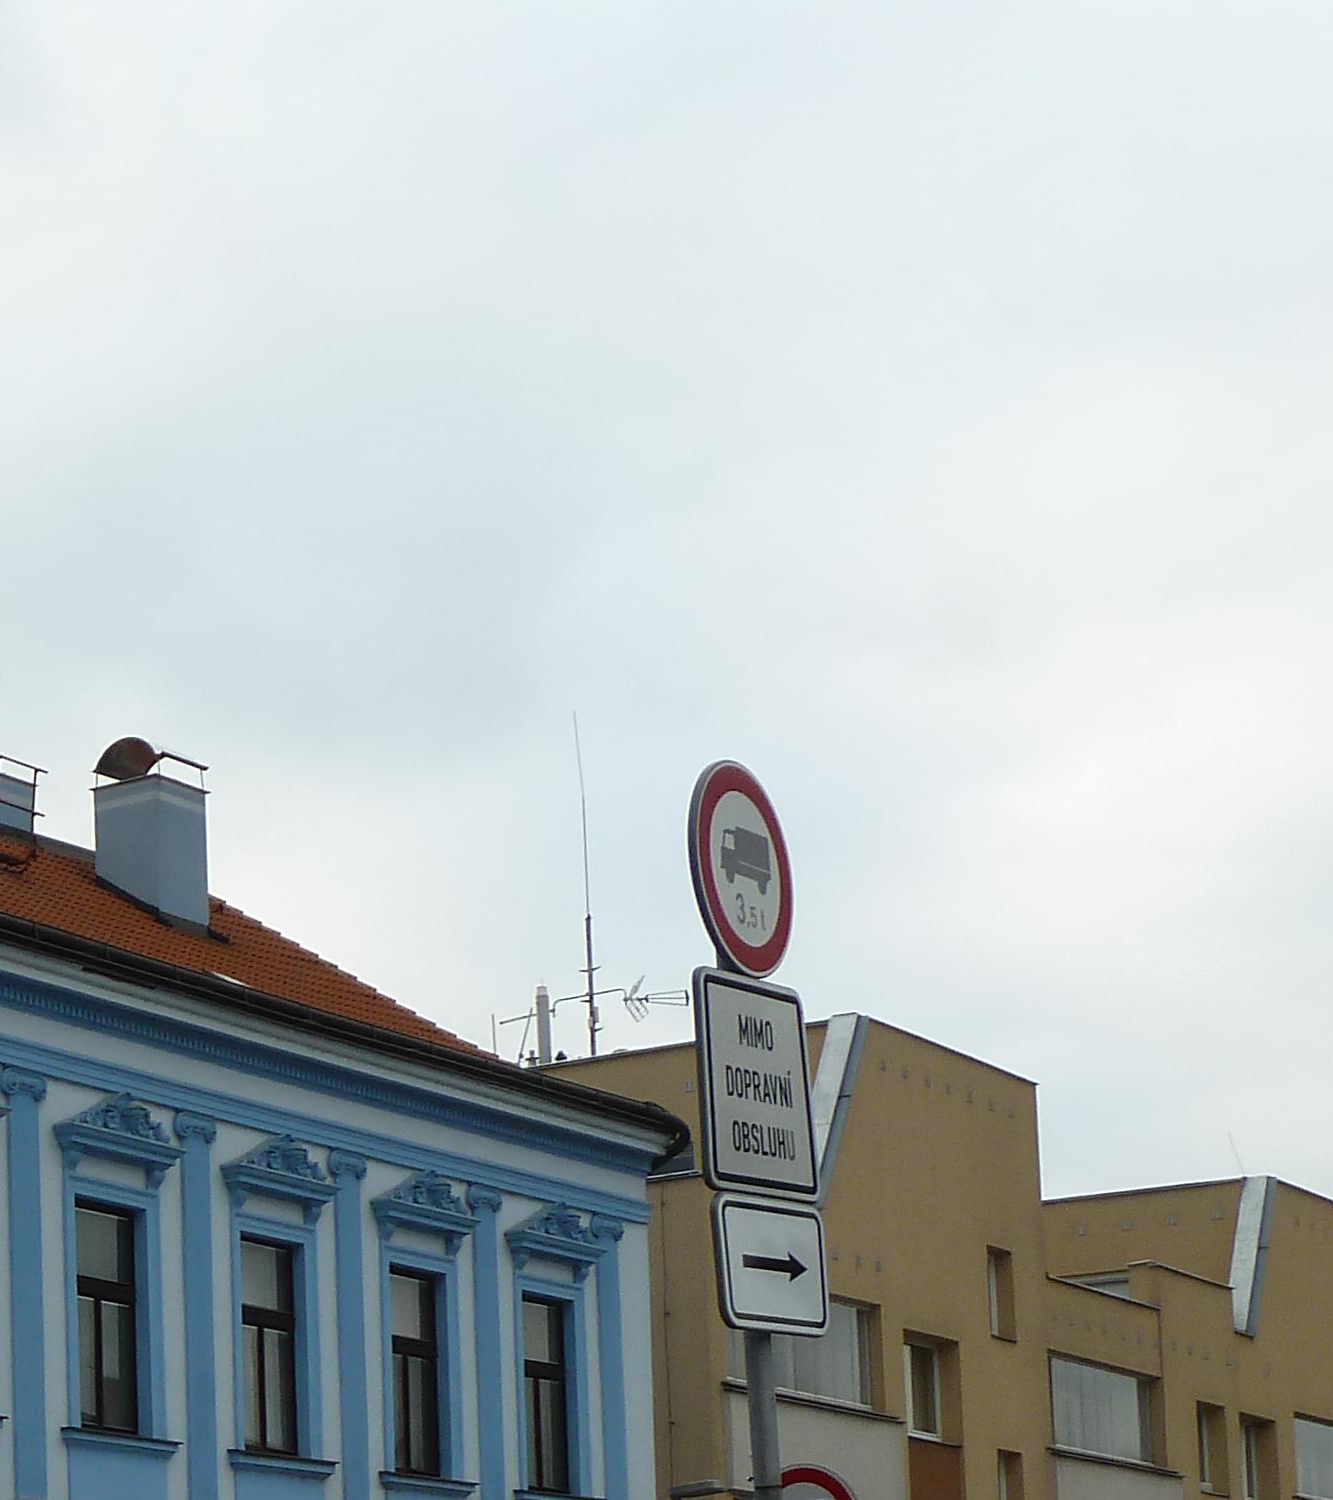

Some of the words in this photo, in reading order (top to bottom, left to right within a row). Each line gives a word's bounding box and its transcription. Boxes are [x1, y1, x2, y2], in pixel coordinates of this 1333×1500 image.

[738, 1012, 774, 1054] MIMO
[725, 1064, 794, 1109] DOPRAVNÍ
[732, 1118, 796, 1162] OBSLUHU
